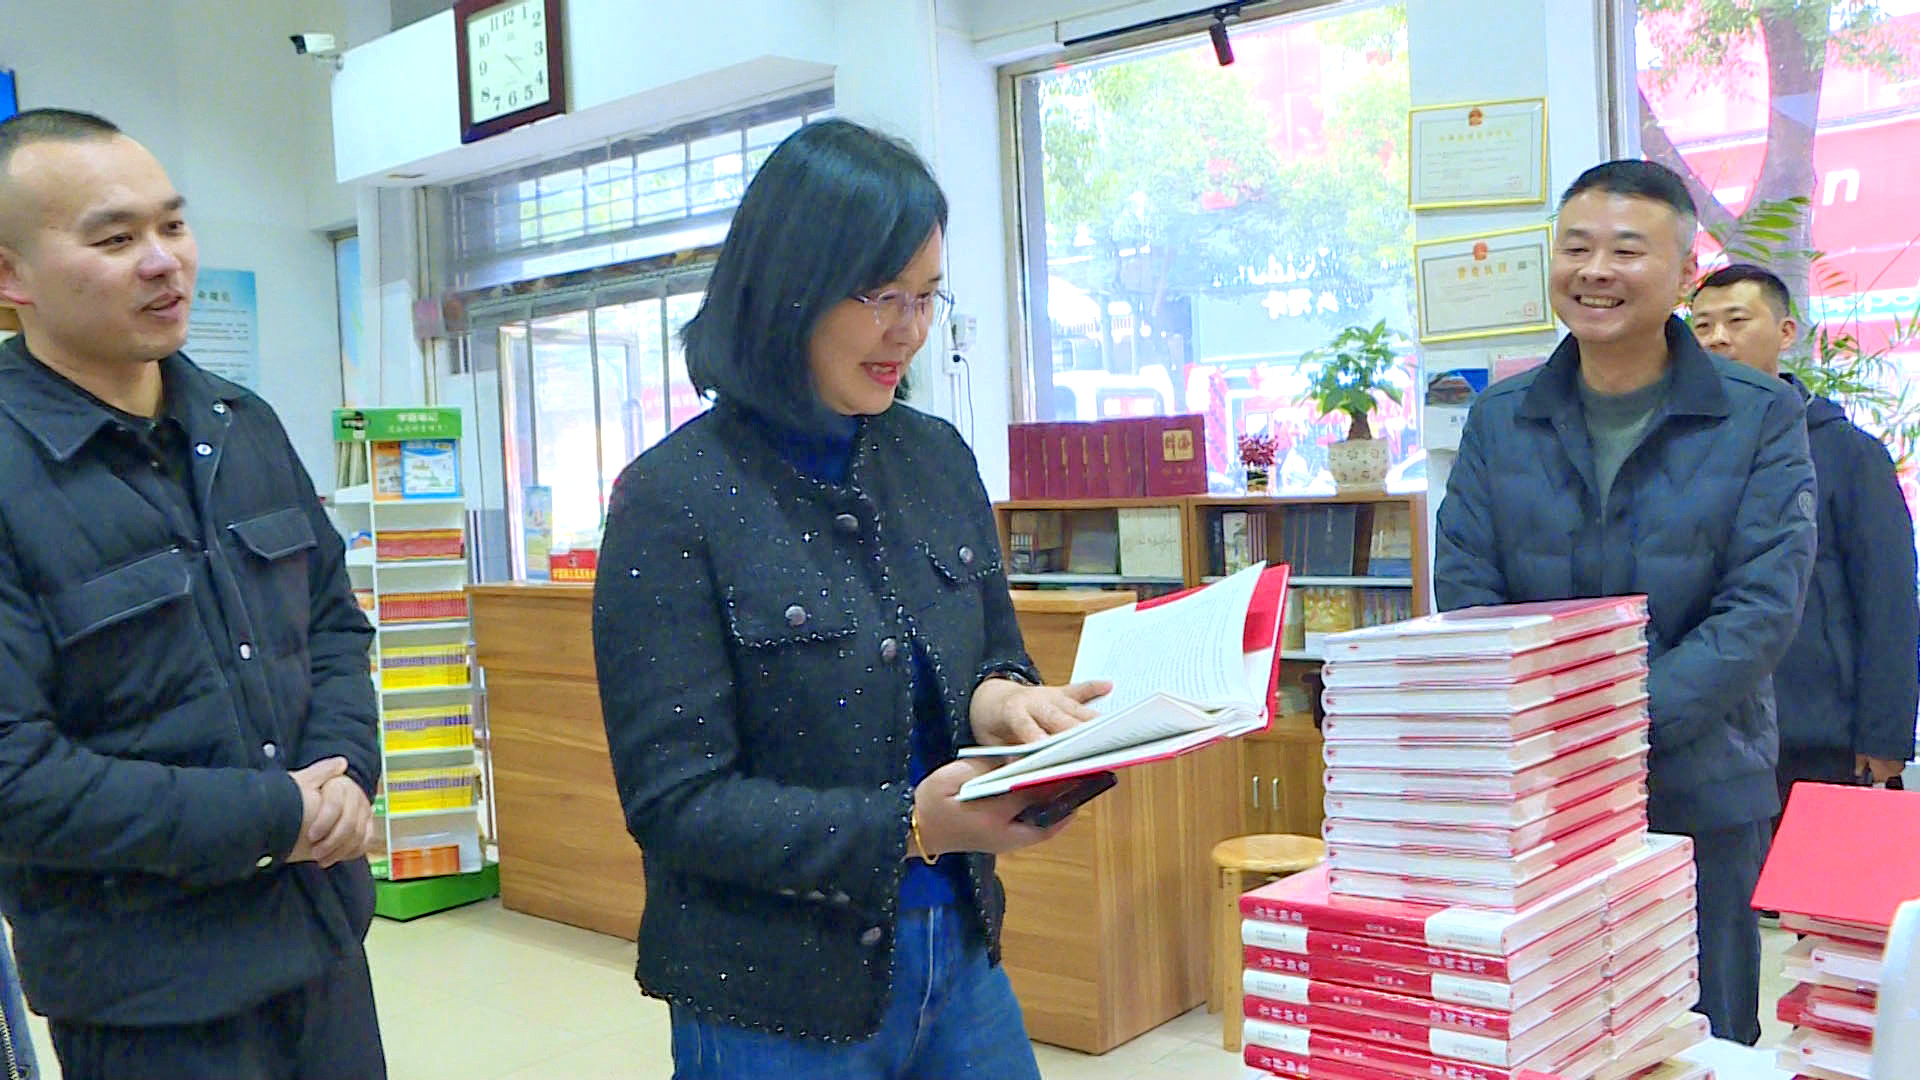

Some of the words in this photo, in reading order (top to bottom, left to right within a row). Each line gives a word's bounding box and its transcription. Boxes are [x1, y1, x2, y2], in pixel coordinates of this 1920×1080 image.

[503, 8, 515, 27] 12
[522, 4, 527, 20] 1
[532, 11, 542, 28] 2
[490, 16, 499, 32] 11
[479, 32, 490, 49] 10
[534, 41, 543, 57] 3
[479, 60, 488, 76] 9
[536, 70, 544, 86] 4
[481, 87, 490, 103] 8
[508, 90, 518, 107] 6
[524, 84, 534, 101] 5
[493, 95, 501, 111] 7
